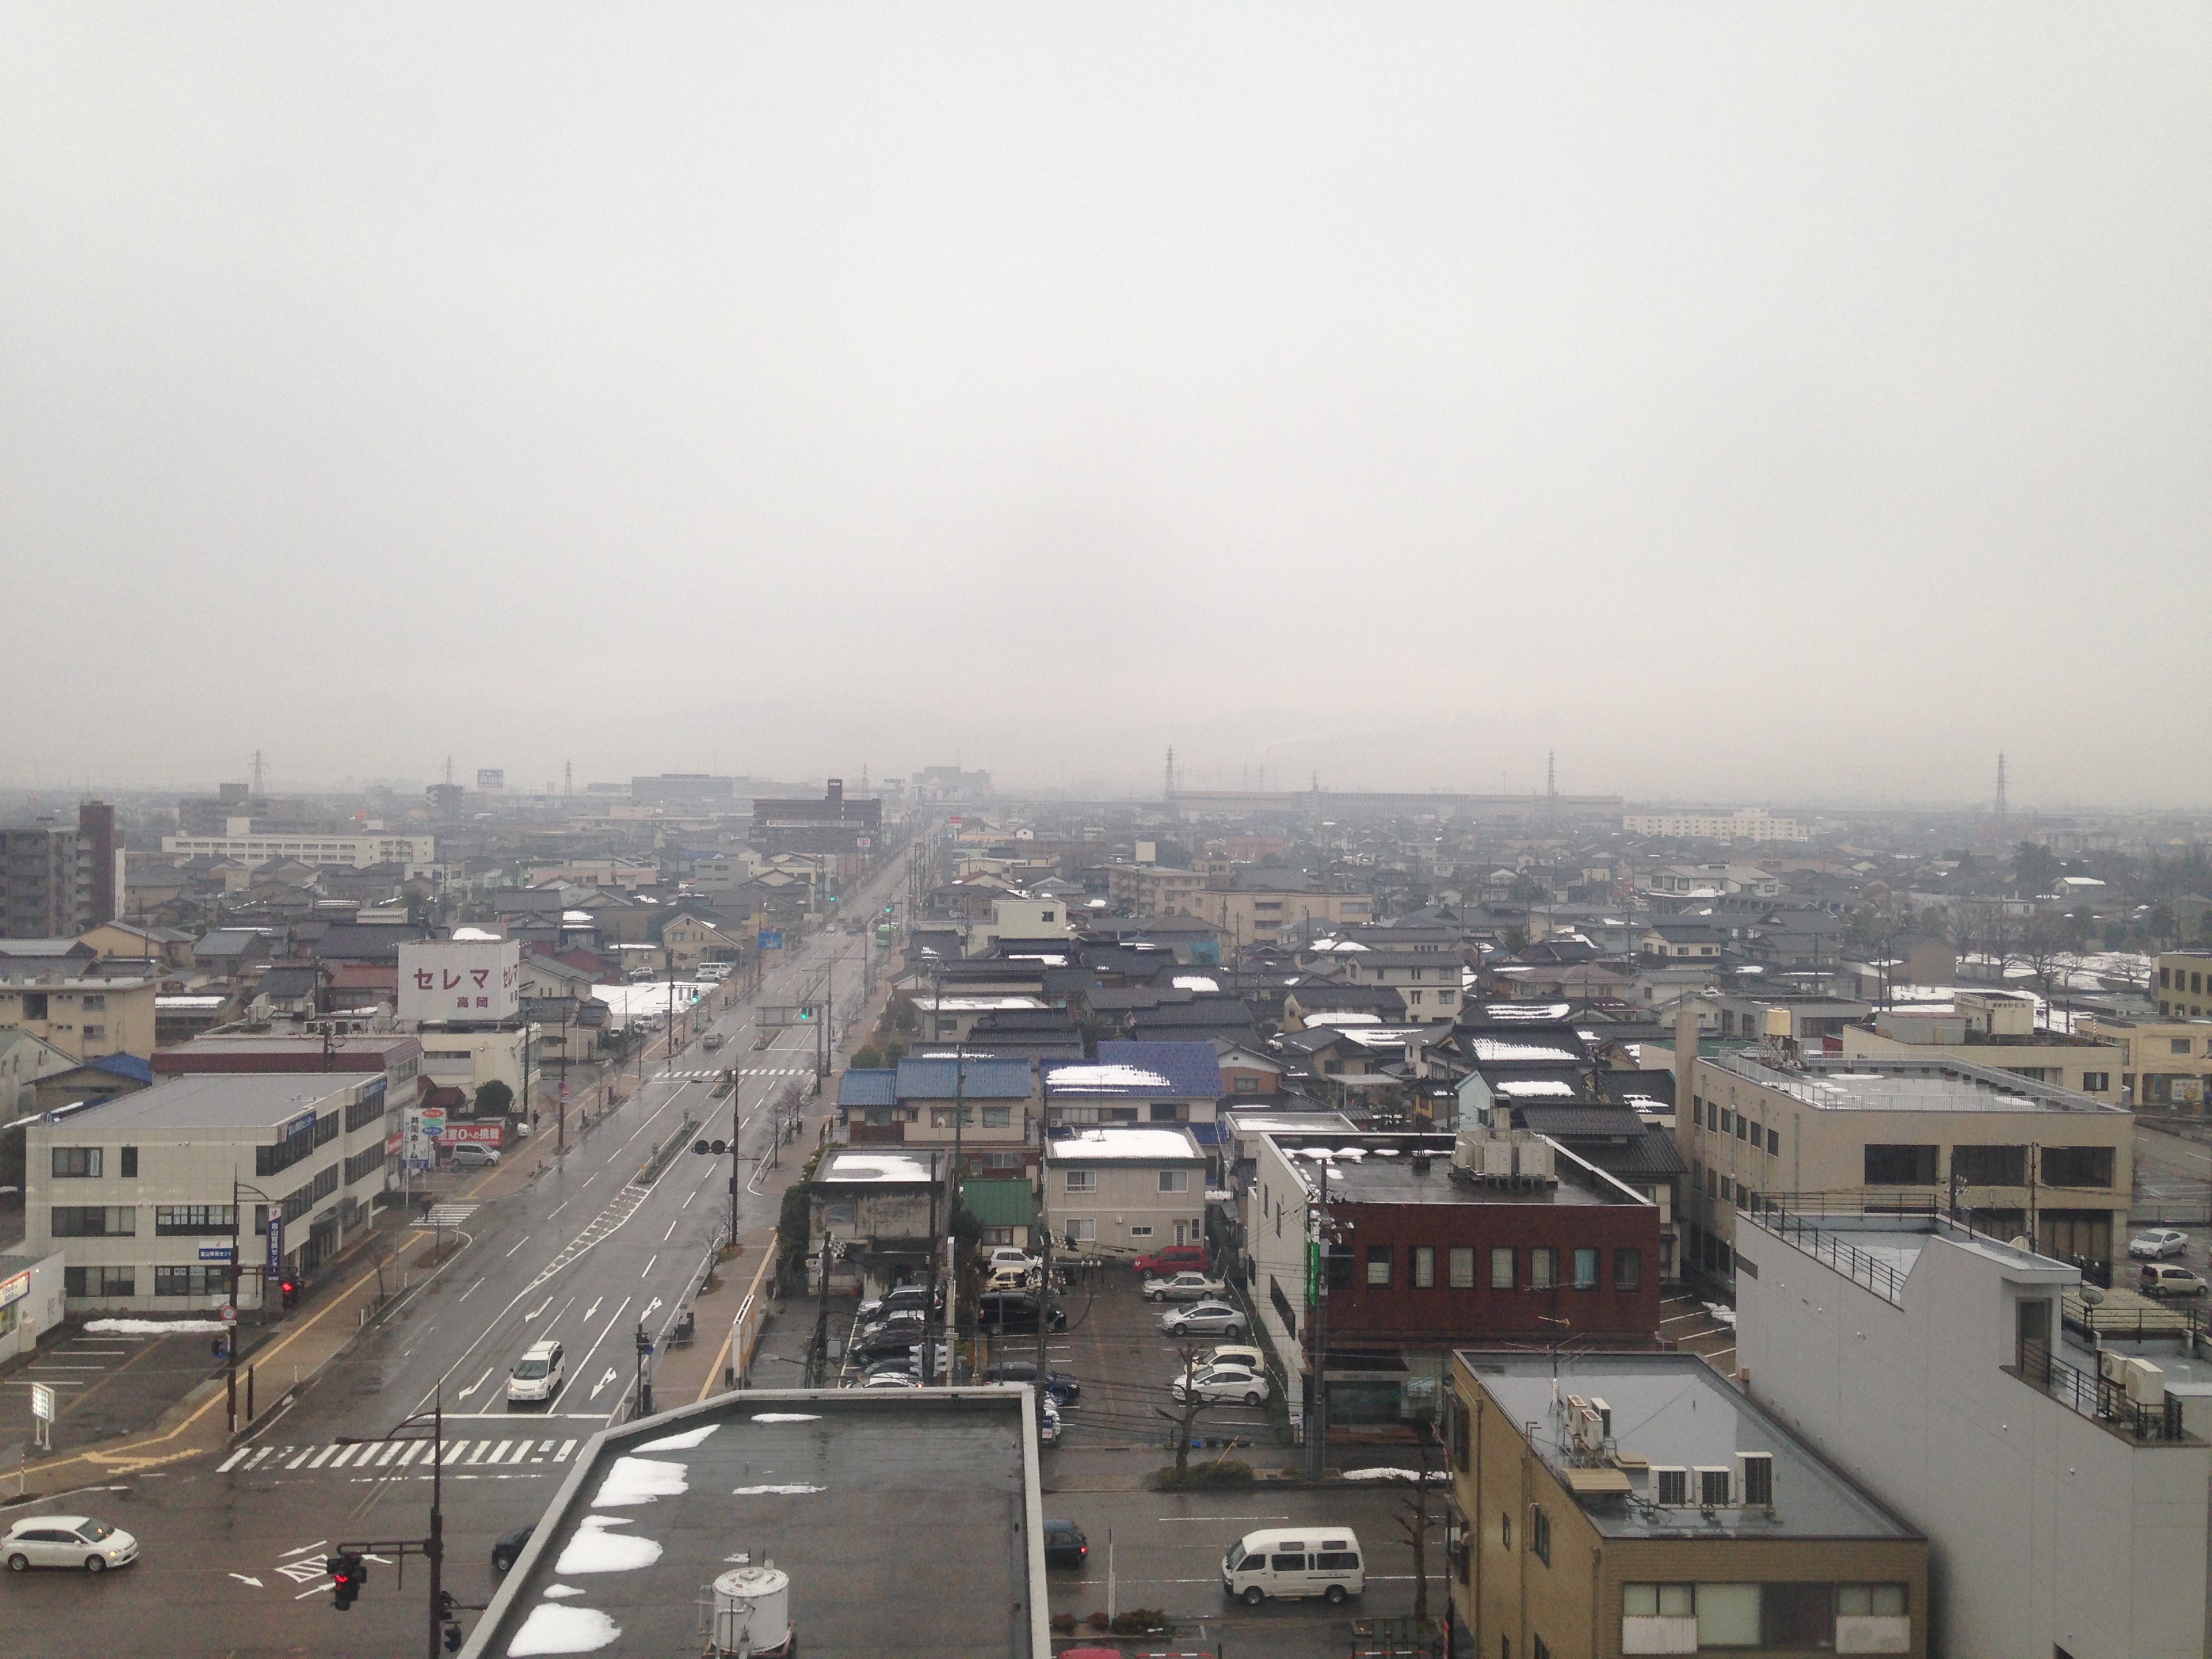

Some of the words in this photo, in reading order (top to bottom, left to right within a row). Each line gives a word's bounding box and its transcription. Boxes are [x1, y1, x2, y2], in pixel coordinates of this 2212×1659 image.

[413, 968, 489, 990] セレマ
[503, 964, 518, 988] セレマ
[457, 997, 488, 1008] 高岡
